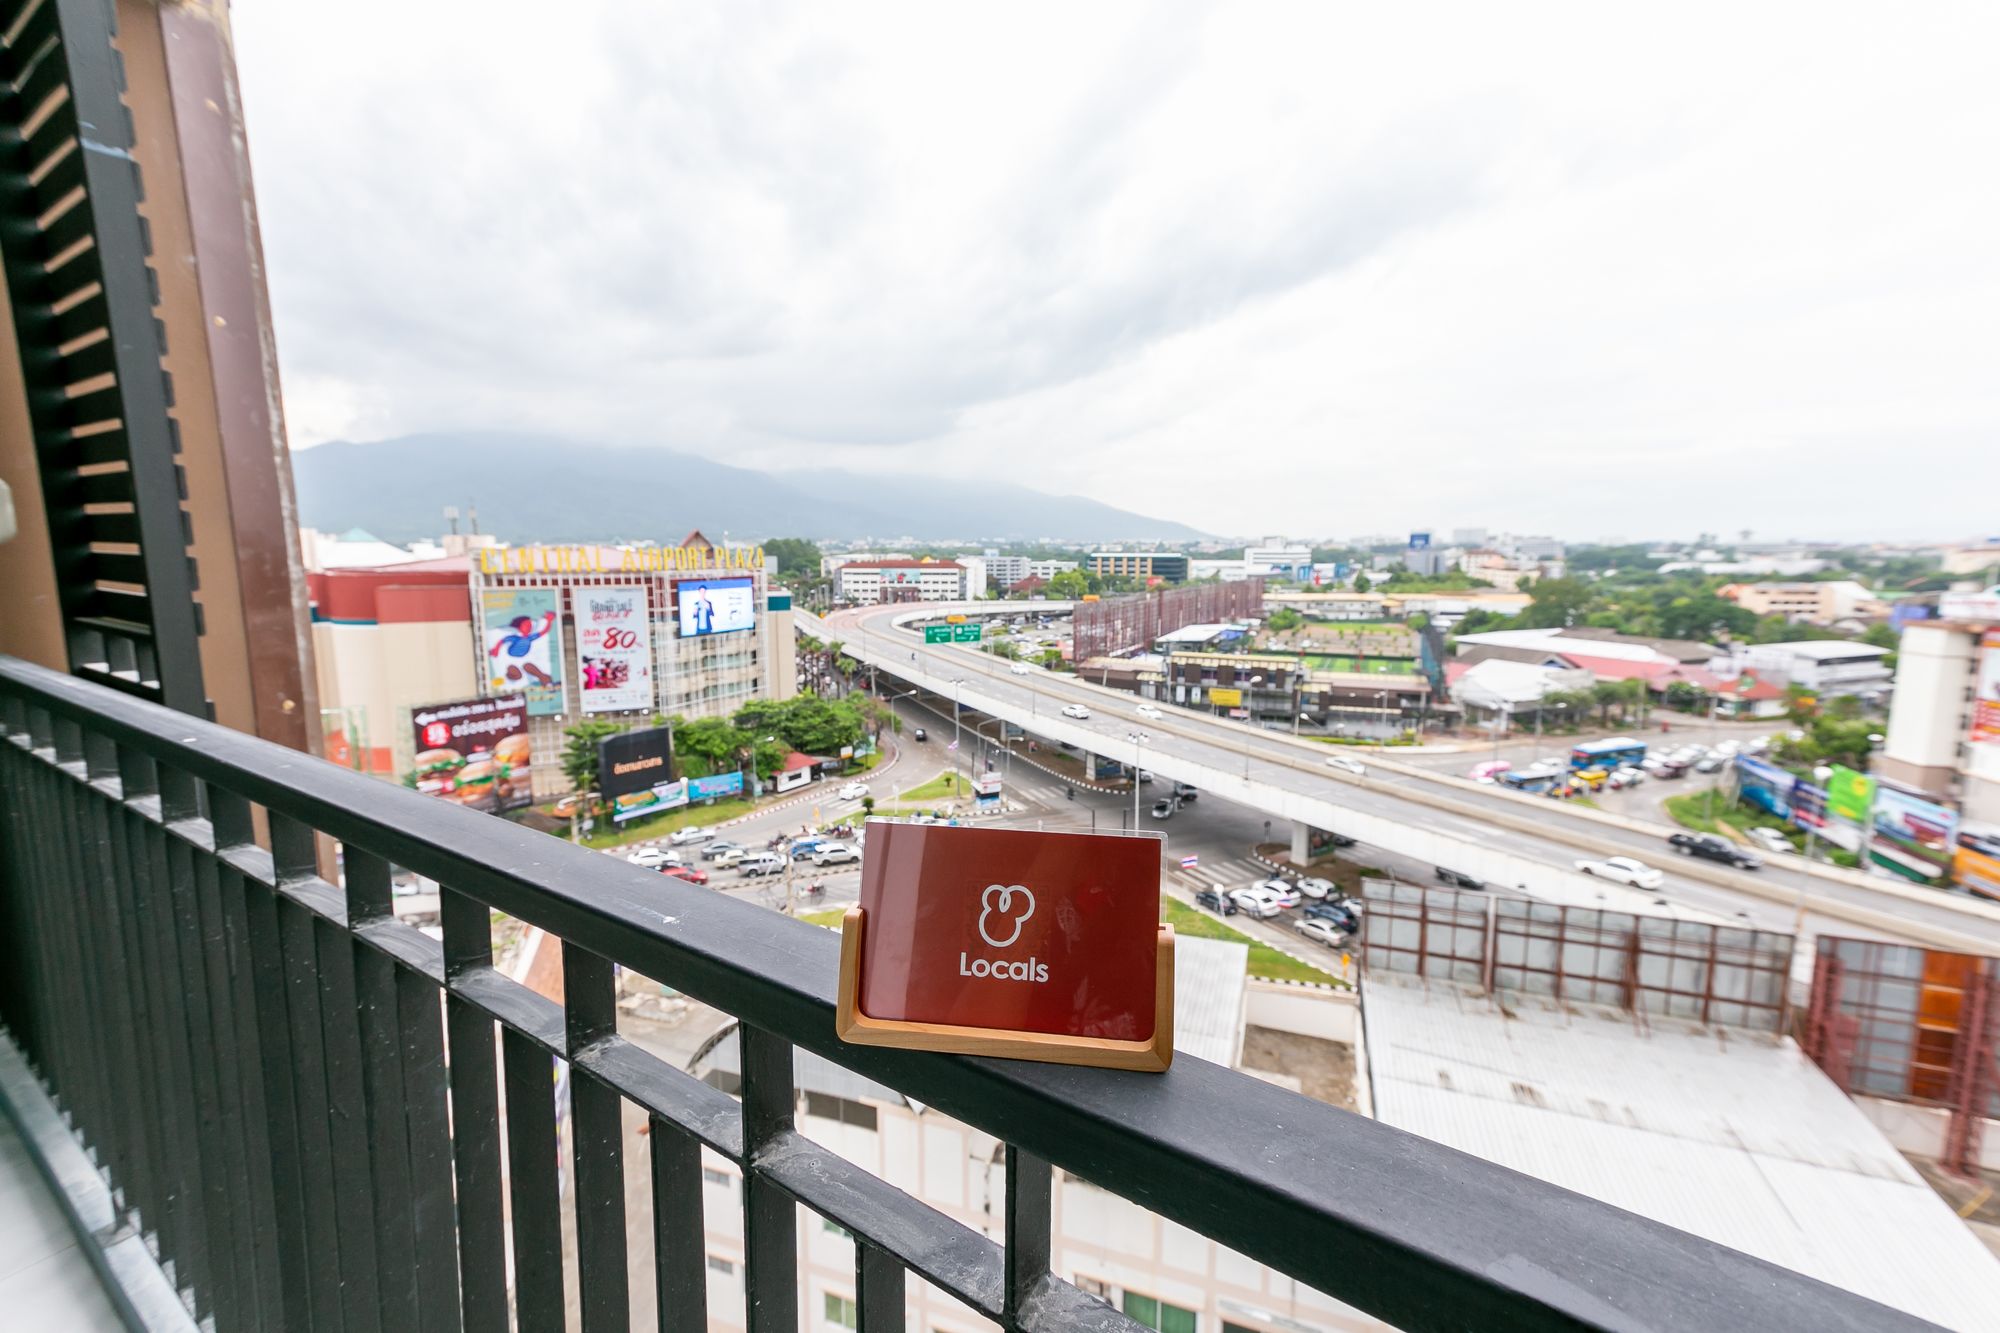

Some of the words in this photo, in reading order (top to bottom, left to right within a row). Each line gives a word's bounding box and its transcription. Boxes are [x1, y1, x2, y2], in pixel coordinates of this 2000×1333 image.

[481, 547, 609, 575] CENTRAL
[621, 547, 710, 572] AIRPORT
[714, 547, 766, 569] PLAZA
[959, 951, 1049, 983] Locals
